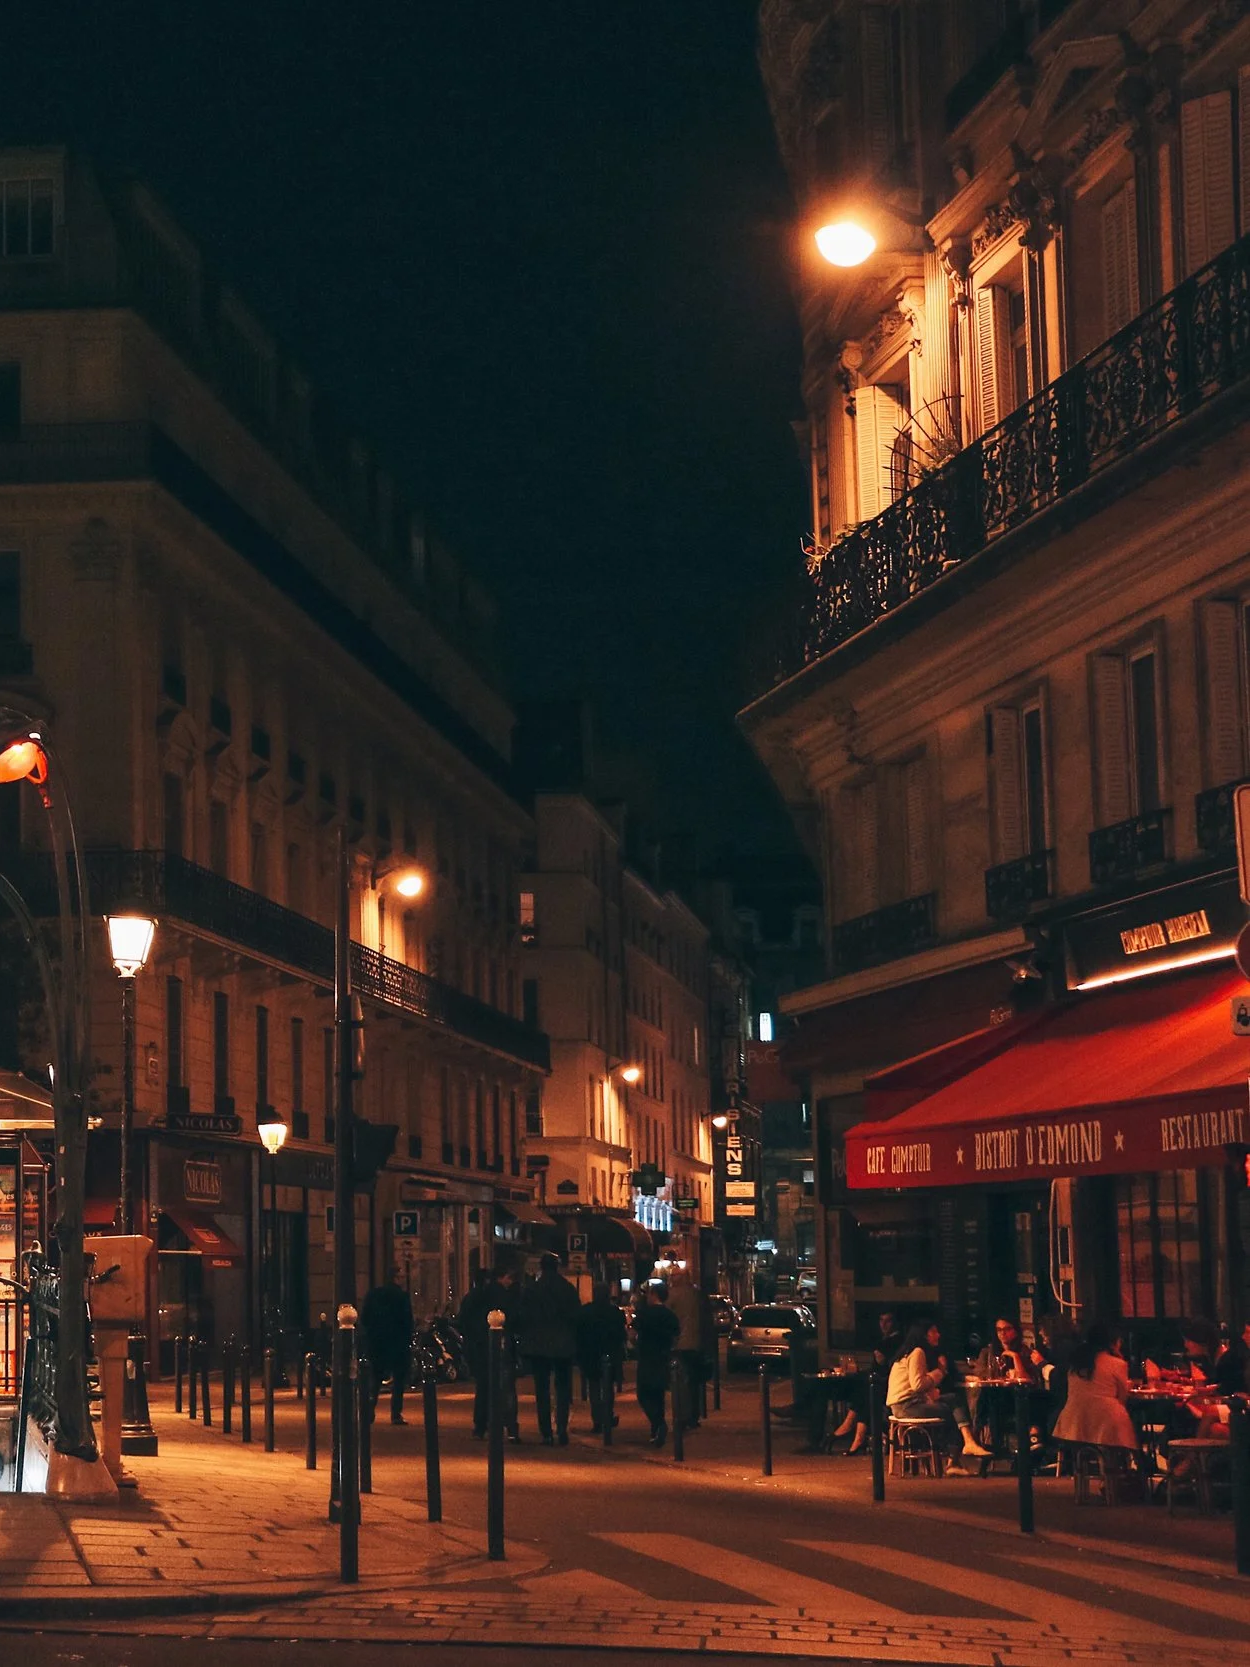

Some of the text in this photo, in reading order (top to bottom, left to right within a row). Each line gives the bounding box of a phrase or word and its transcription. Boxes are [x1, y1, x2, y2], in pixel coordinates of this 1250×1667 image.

[174, 1115, 232, 1131] NICOLAS
[1160, 1108, 1244, 1152] RESTAURANT
[866, 1142, 932, 1175] CAFE COMPTOIR
[974, 1120, 1102, 1171] BISTROT D'EDMOND
[186, 1169, 220, 1195] NICOLAS
